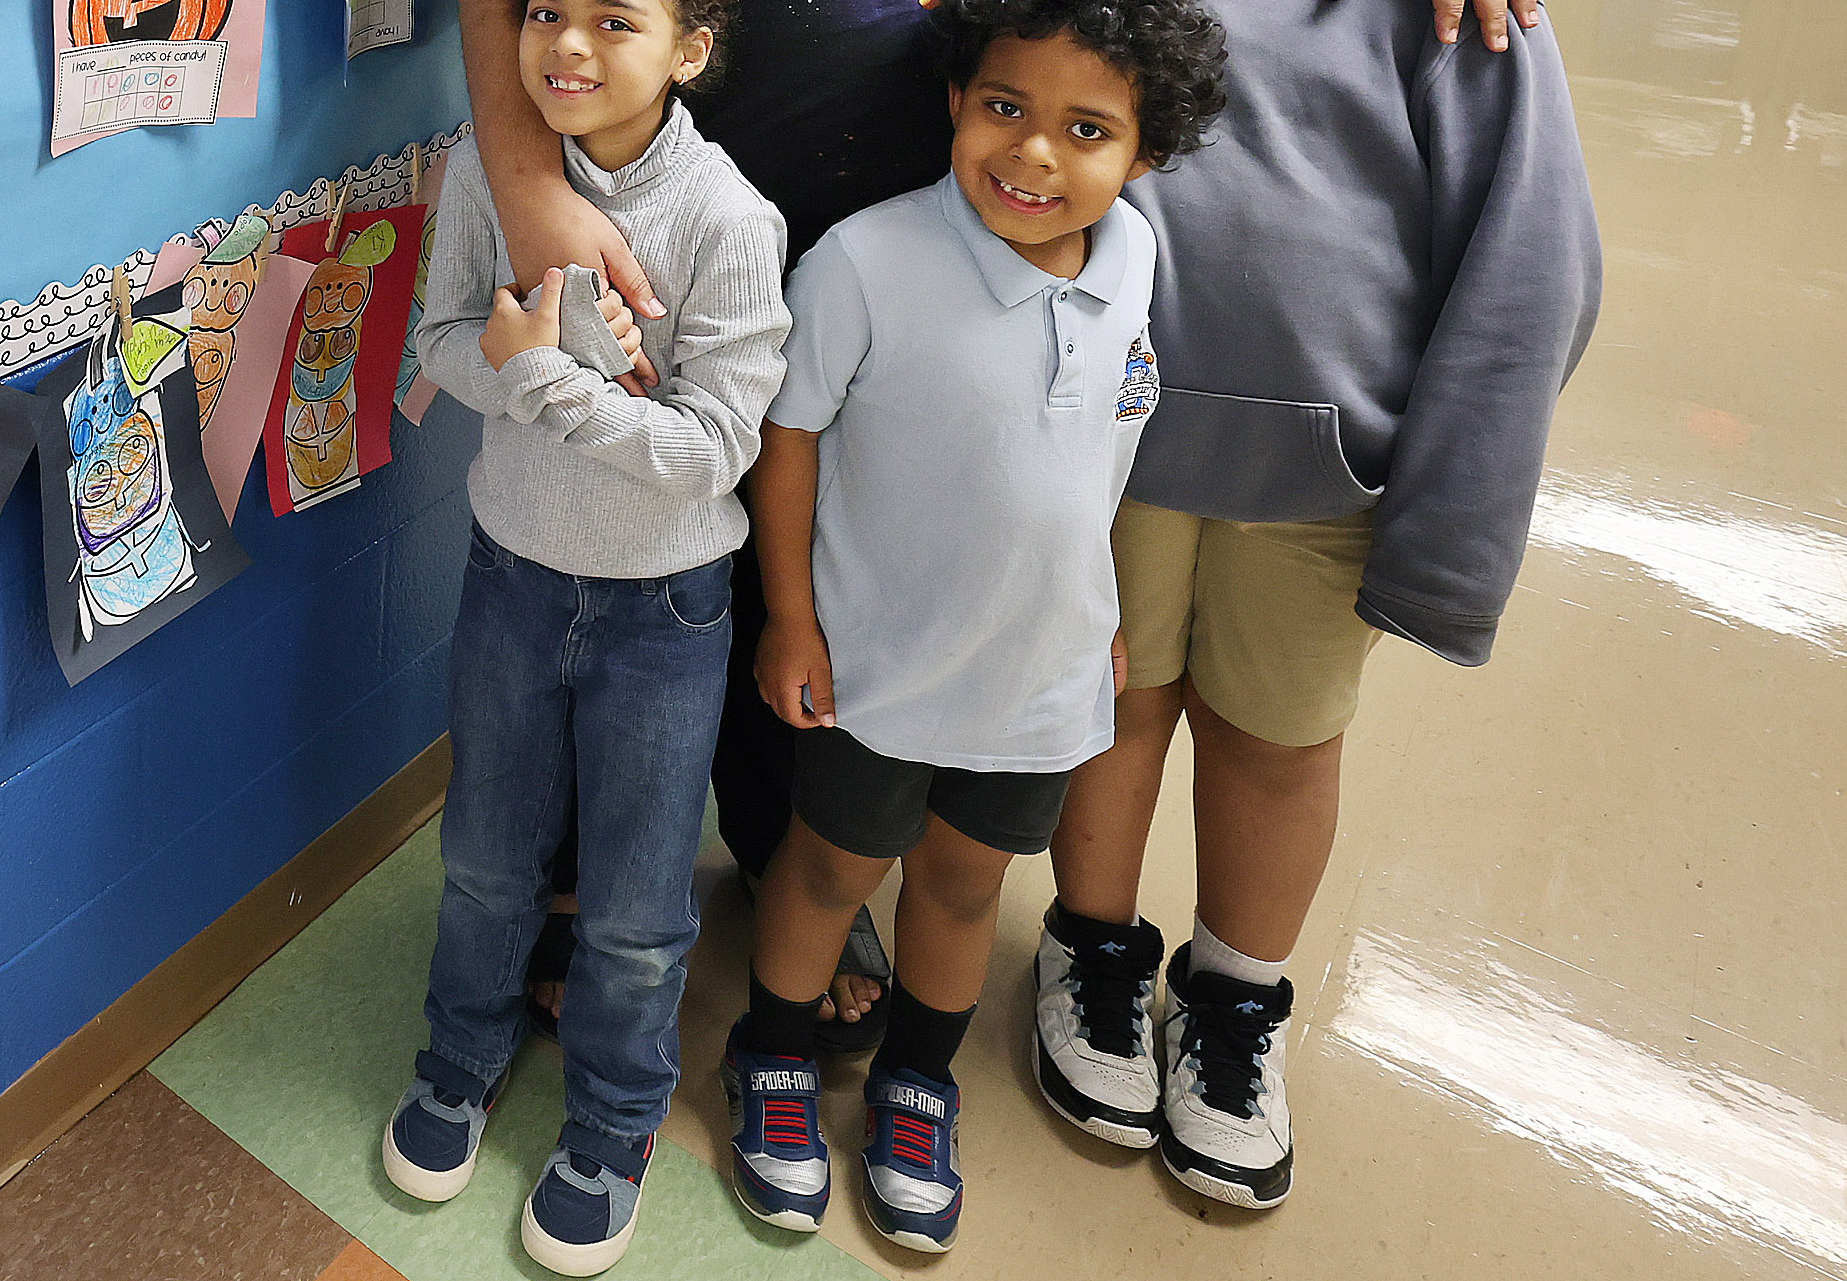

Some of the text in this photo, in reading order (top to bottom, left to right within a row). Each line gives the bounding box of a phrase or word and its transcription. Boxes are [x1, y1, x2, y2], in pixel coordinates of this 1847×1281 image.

[76, 60, 97, 72] have
[129, 51, 157, 66] pieces
[159, 50, 172, 62] of
[174, 50, 207, 65] candy!
